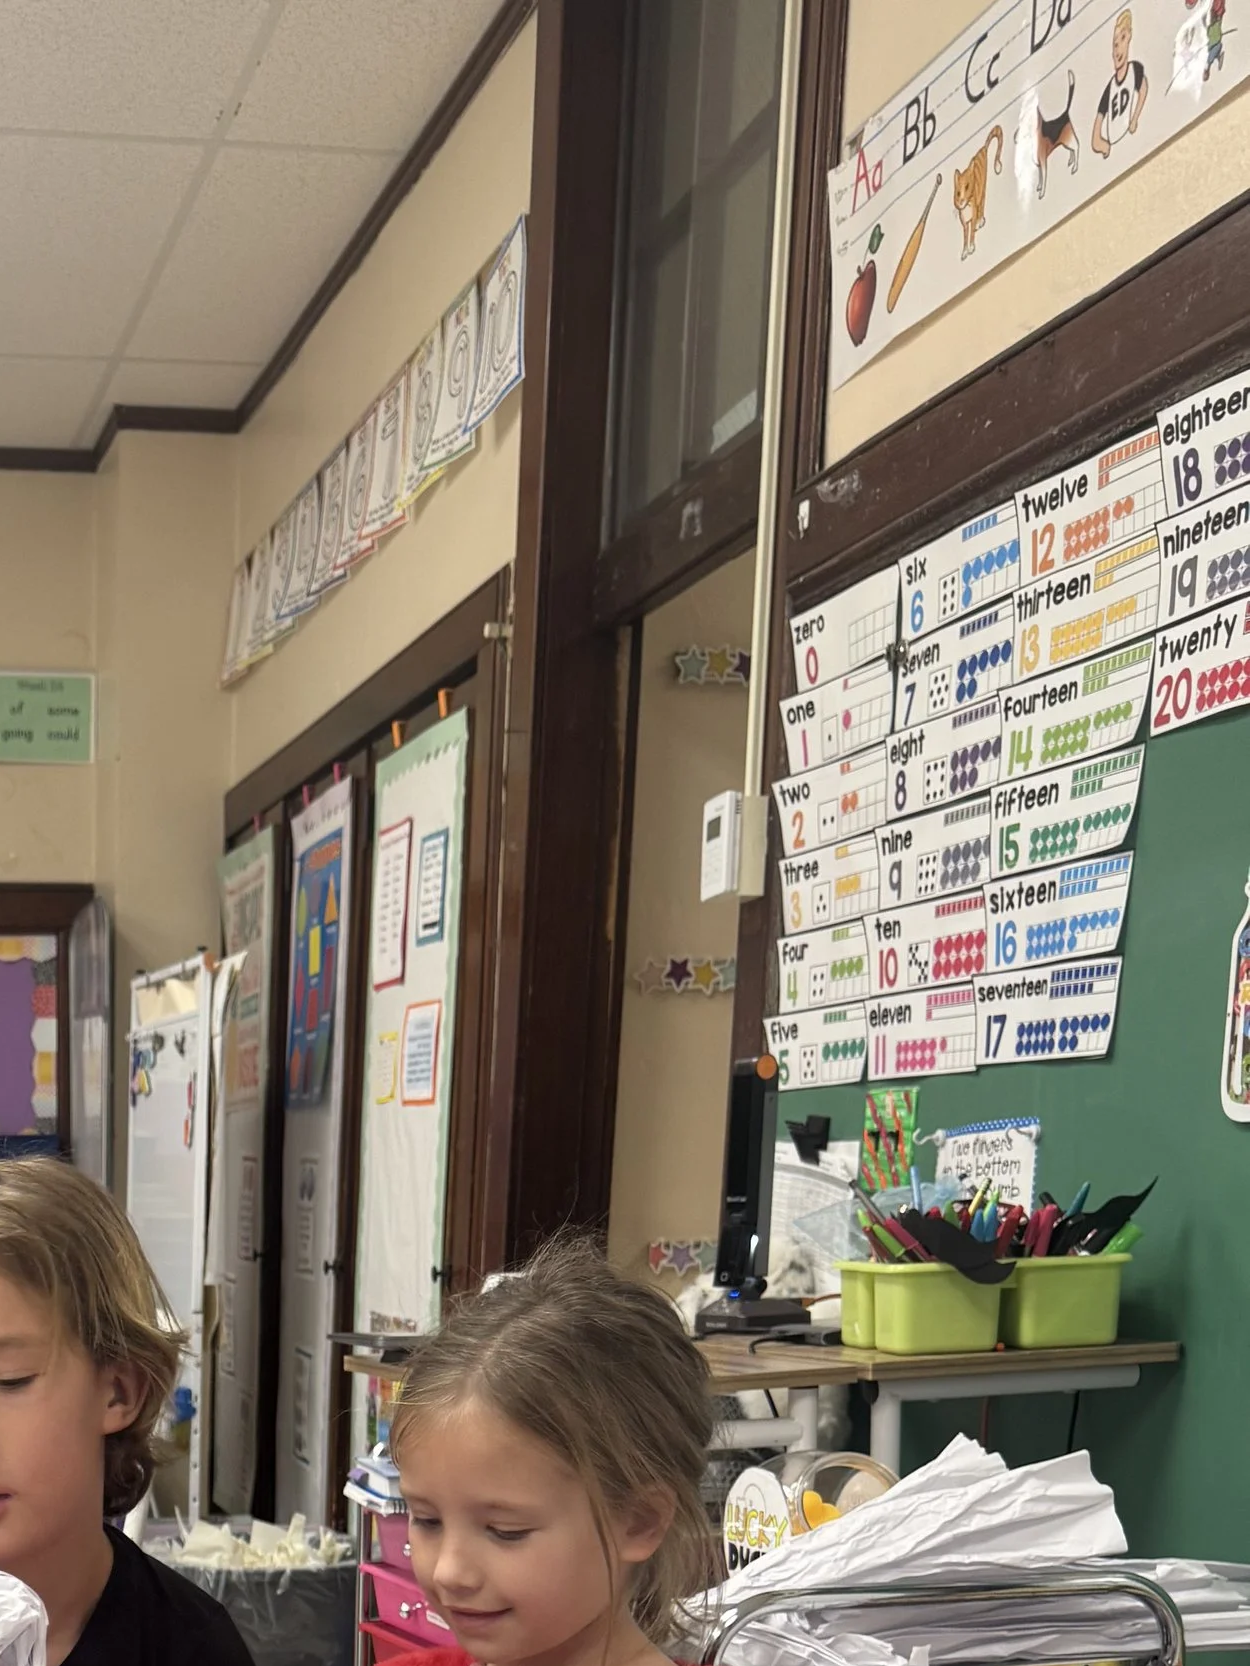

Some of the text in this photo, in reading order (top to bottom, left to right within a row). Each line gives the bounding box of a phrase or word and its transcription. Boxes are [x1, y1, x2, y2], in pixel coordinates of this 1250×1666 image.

[852, 147, 884, 214] Aa
[902, 87, 936, 165] Bb
[964, 33, 1001, 104] Cc
[1111, 88, 1130, 121] ED
[1173, 447, 1203, 508] 18
[1022, 474, 1088, 523] twelve
[1163, 500, 1250, 559] nineteen
[1031, 522, 1055, 578] 12
[906, 557, 927, 586] six
[1168, 555, 1199, 617] 19
[910, 589, 924, 633] 6
[1017, 573, 1090, 623] thirteen
[794, 615, 825, 645] zero
[1159, 613, 1238, 668] twenty
[806, 646, 819, 685] 0
[901, 642, 940, 678] seven
[1019, 624, 1040, 676] 13
[786, 700, 816, 725] one
[904, 682, 917, 727] 7
[1003, 680, 1078, 722] fourteen
[1153, 667, 1193, 728] 20
[801, 729, 809, 768] 1
[890, 728, 925, 766] eight
[1007, 725, 1033, 776] 14
[779, 782, 811, 807] two
[895, 770, 907, 812] 8
[994, 781, 1059, 819] fifteen
[791, 810, 806, 850] 2
[881, 829, 913, 856] nine
[999, 822, 1021, 871] 15
[783, 860, 819, 886] three
[889, 860, 902, 901] 9
[791, 890, 802, 929] 3
[989, 879, 1057, 915] sixteen
[875, 917, 901, 942] ten
[994, 919, 1017, 967] 16
[782, 942, 809, 965] four
[879, 947, 898, 990] 10
[786, 969, 798, 1006] 4
[977, 978, 1048, 1002] seventeen
[770, 1021, 798, 1044] five
[869, 1003, 911, 1028] eleven
[874, 1034, 886, 1075] 11
[984, 1013, 1007, 1059] 17
[779, 1049, 790, 1085] 5
[951, 1135, 1013, 1158] Two fingers
[976, 1156, 1021, 1178] bottom
[727, 1503, 789, 1548] LUCKY
[728, 1541, 767, 1571] DU
